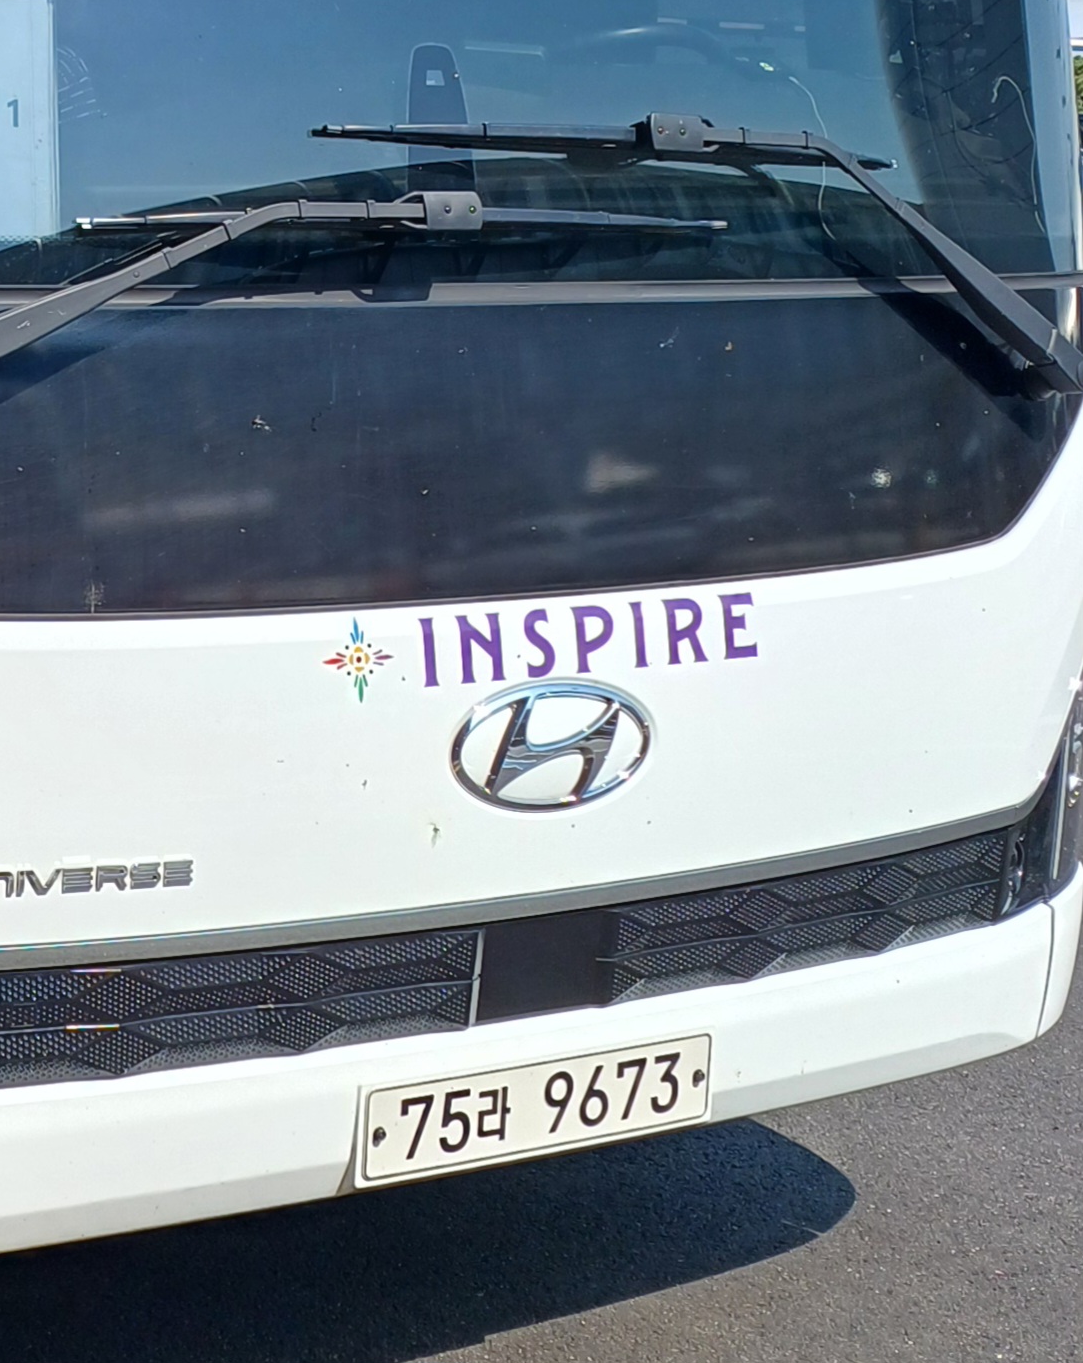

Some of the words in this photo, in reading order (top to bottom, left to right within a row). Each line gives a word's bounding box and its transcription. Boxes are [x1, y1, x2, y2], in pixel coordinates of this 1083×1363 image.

[6, 99, 20, 128] 1
[418, 592, 759, 688] INSPIRE
[400, 1086, 511, 1160] 75라
[544, 1052, 681, 1134] 9673
